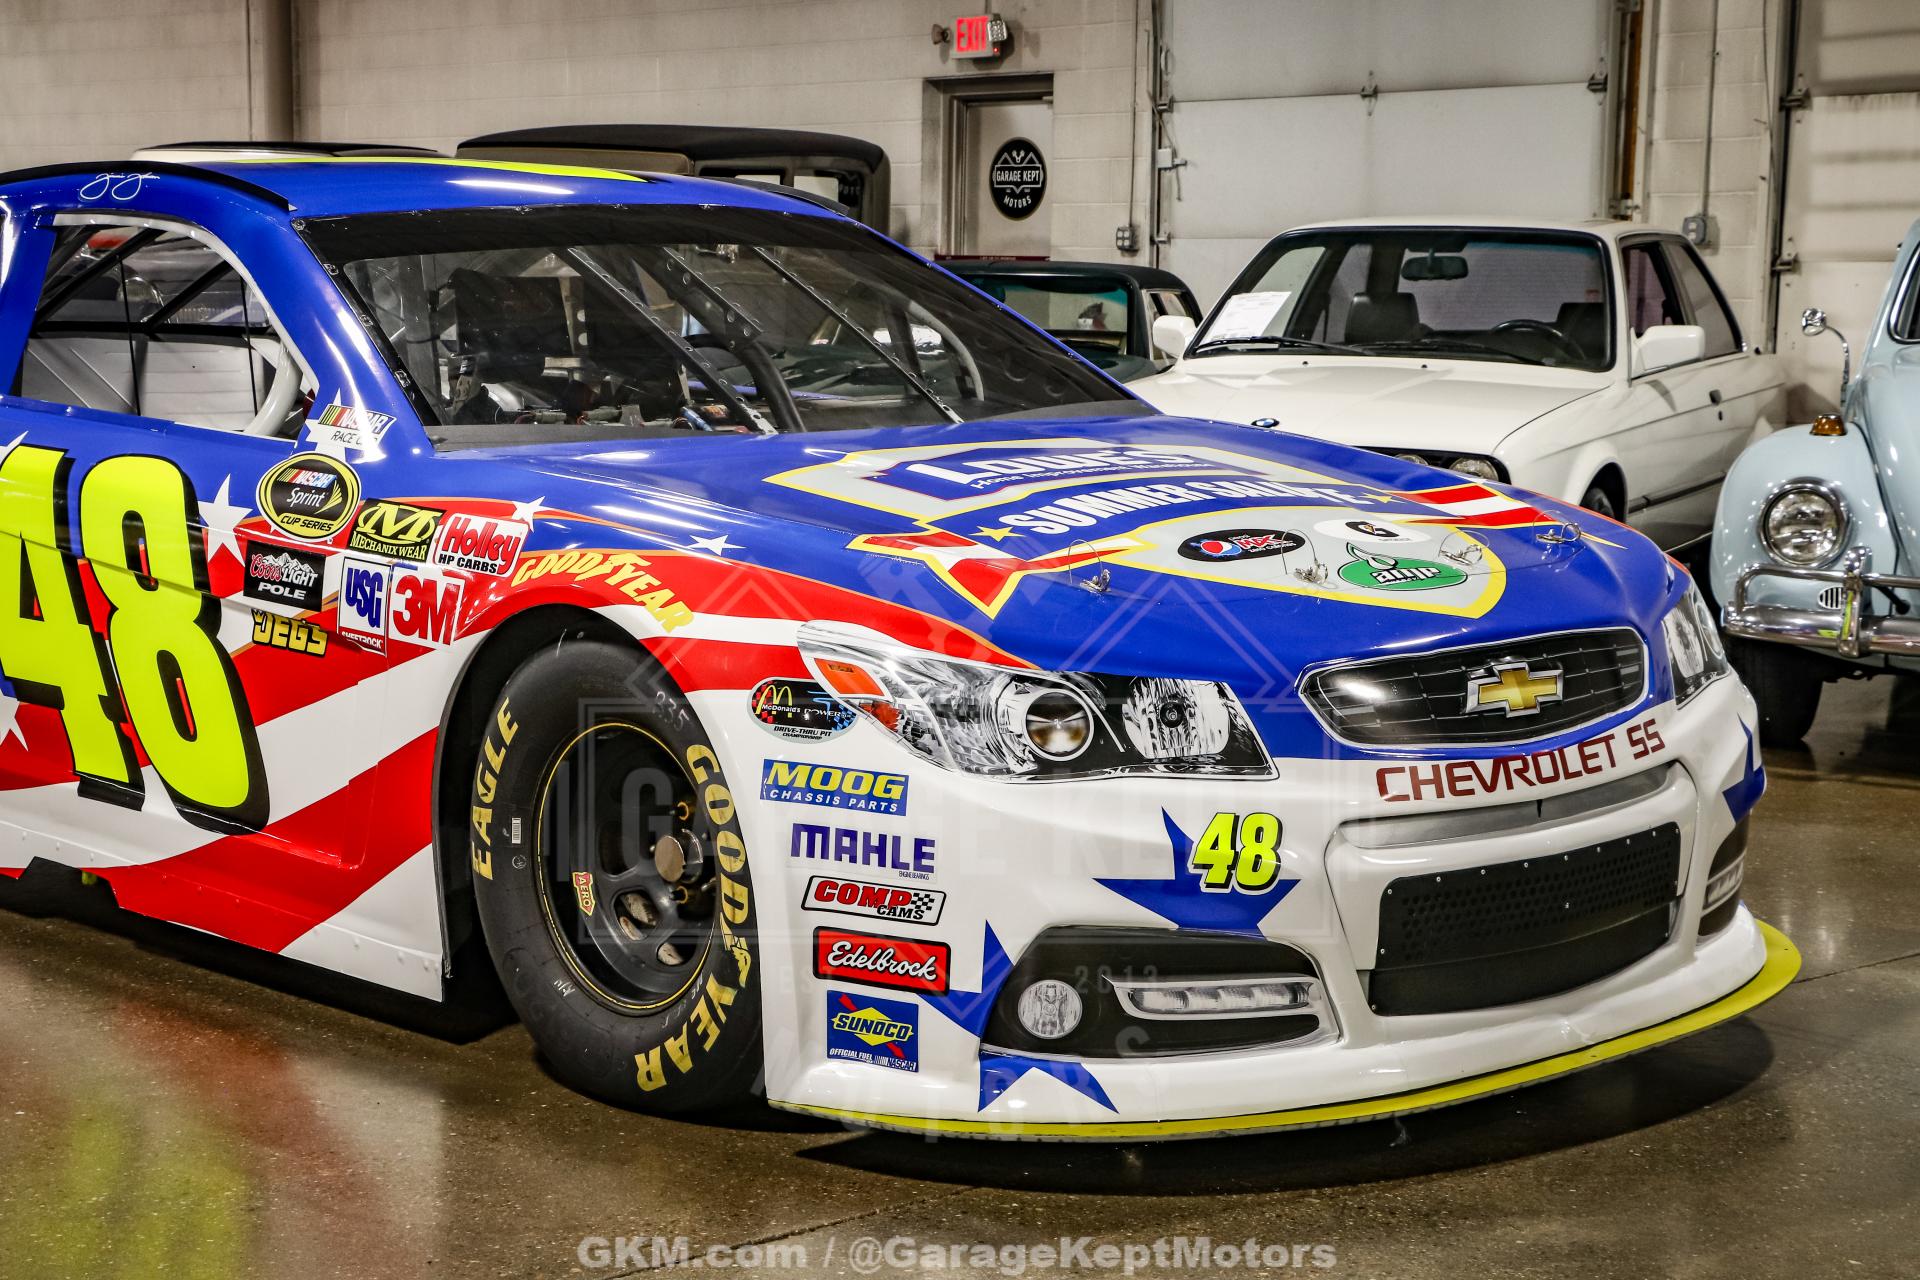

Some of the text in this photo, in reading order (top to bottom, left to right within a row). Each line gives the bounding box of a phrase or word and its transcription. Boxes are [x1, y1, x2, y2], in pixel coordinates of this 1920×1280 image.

[957, 16, 988, 52] EXIT
[996, 170, 1040, 181] GARAGE KEPT
[1004, 195, 1032, 208] MOTORS
[331, 430, 357, 444] RACE
[293, 470, 334, 488] NASCAR
[287, 488, 325, 508] Sprint
[998, 484, 1217, 535] SUMMER
[280, 515, 334, 532] CUP SERIES
[350, 531, 428, 561] MECHANIX WEAR
[442, 516, 521, 575] Holley
[250, 554, 318, 587] Coors LIGHT
[438, 553, 499, 573] HP CARBS
[258, 582, 307, 600] POLE
[345, 567, 383, 628] USG
[511, 551, 694, 634] GOODYEAR
[393, 575, 461, 645] 3M
[0, 444, 262, 822] 48
[761, 704, 800, 713] McDonald's
[774, 726, 819, 735] DRIVE-THRU
[1375, 718, 1666, 802] CHEVROLET SS
[471, 697, 519, 881] EAGLE
[766, 762, 905, 800] MOOG
[769, 789, 898, 812] CHASSIS PARTS
[791, 822, 935, 873] MAHLE
[1192, 812, 1283, 891] 48
[577, 876, 592, 909] AERO
[814, 880, 913, 910] COMP
[635, 744, 751, 1092] GOODYEAR
[876, 904, 925, 920] CAMS
[827, 941, 937, 981] Edelbrock
[836, 1014, 911, 1041] SUNOCO
[829, 1048, 857, 1057] OFFICIAL
[858, 1052, 873, 1061] FUEL
